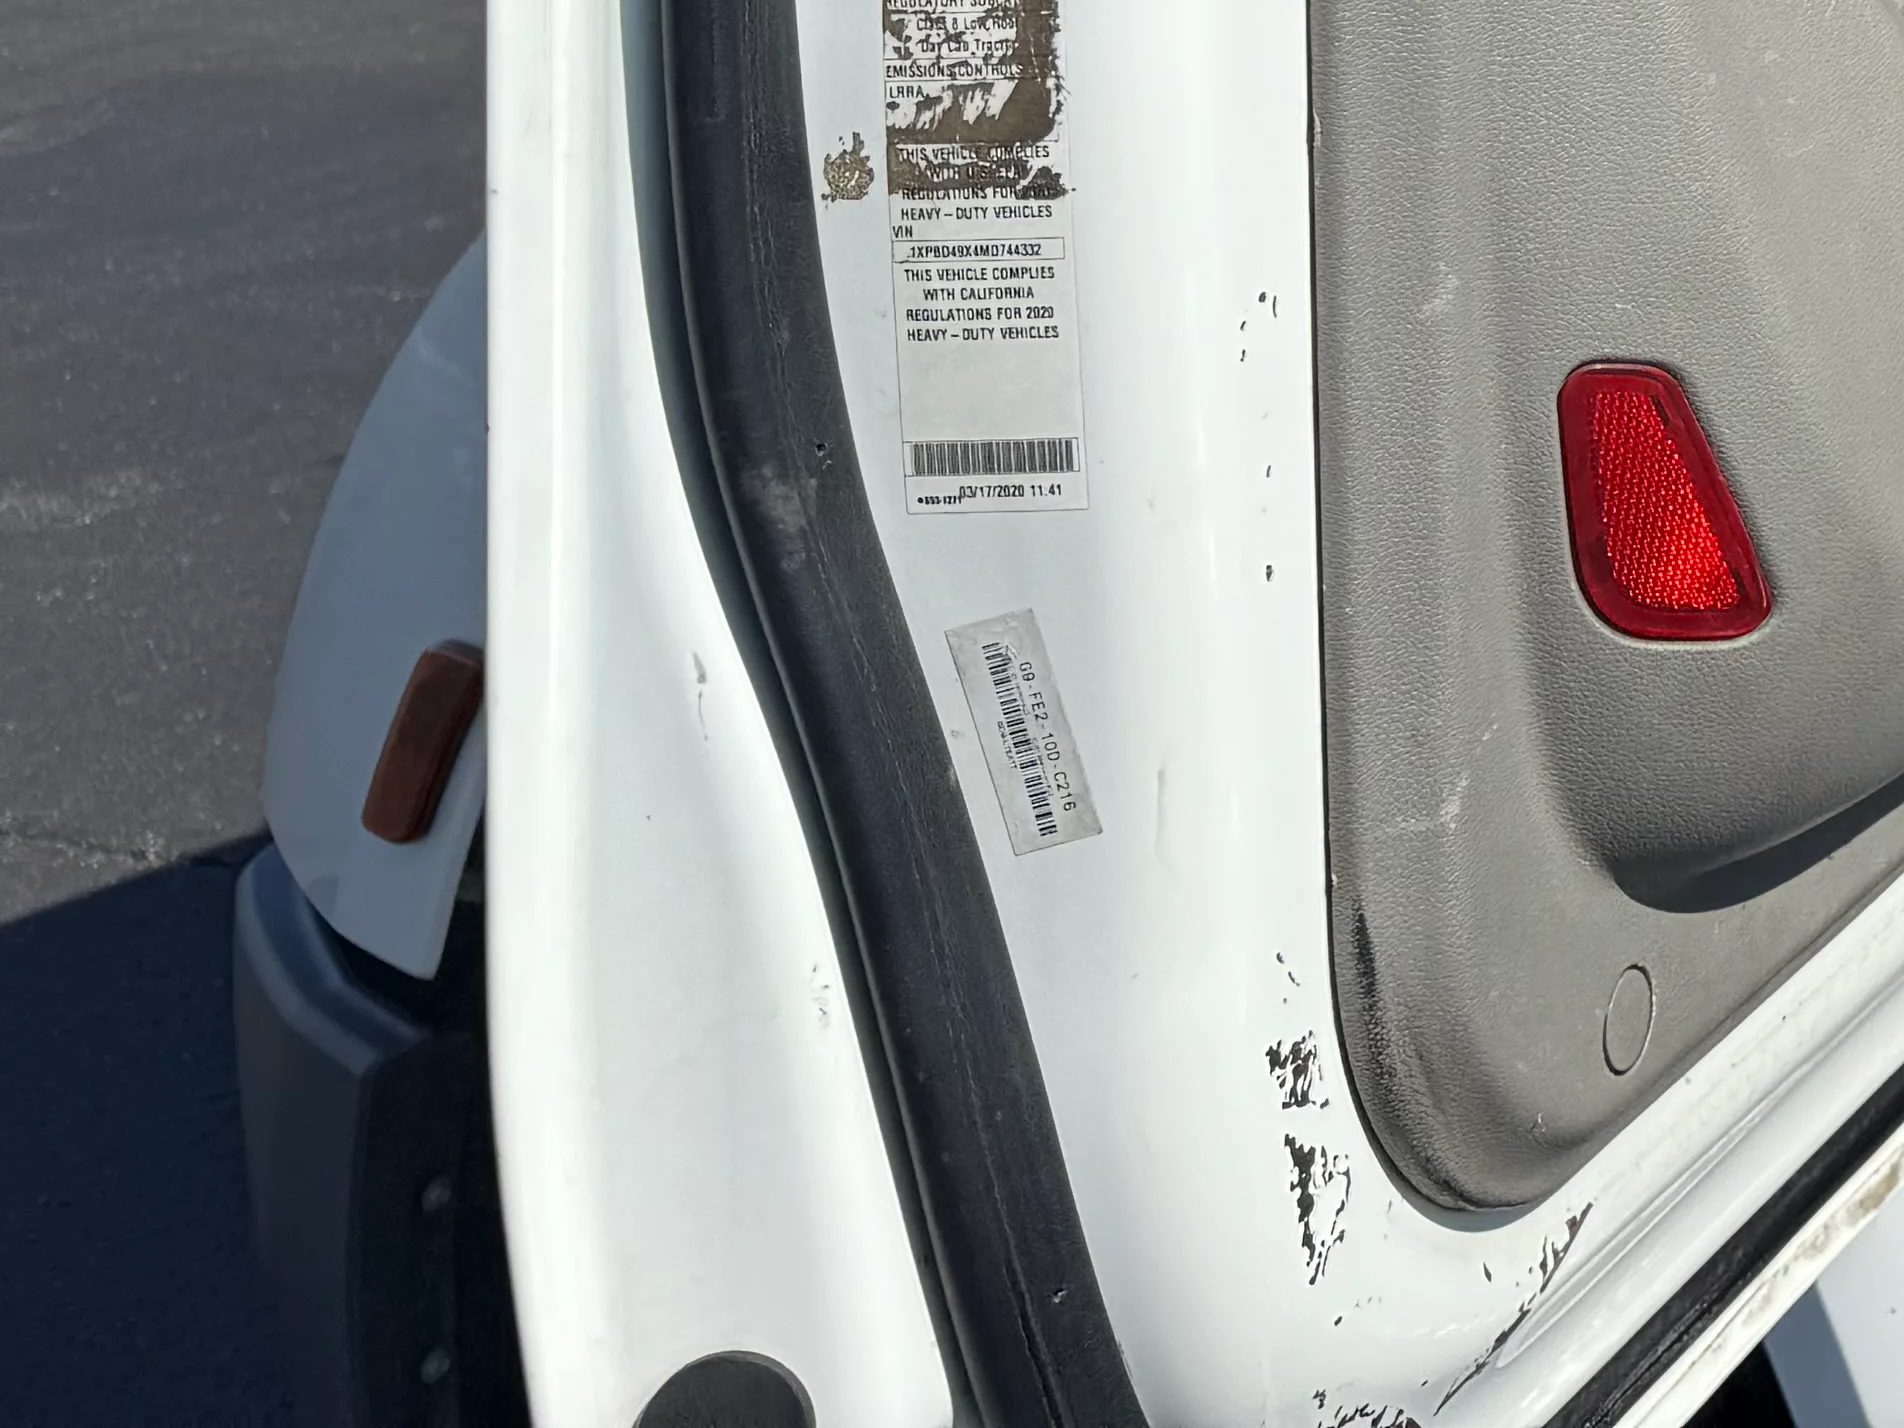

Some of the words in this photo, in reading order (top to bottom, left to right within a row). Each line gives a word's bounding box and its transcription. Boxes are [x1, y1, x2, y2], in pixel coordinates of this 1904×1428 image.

[886, 64, 953, 78] EMISSIONS
[900, 207, 941, 221] HEAVY
[956, 207, 988, 220] DUTY
[993, 205, 1053, 219] VEHICLES
[892, 225, 913, 239] VIN
[904, 268, 932, 282] THIS
[936, 267, 987, 282] VEHICLE
[992, 266, 1055, 280] COMPLIES
[923, 287, 955, 301] WITH
[960, 286, 1035, 301] CALIFORNIA
[906, 307, 992, 322] REGULATIONS
[997, 307, 1022, 321] FOR
[1025, 306, 1055, 320] 2020
[907, 328, 948, 342] HEAVY
[962, 327, 995, 341] DUTY
[1000, 325, 1060, 340] VEHICLES
[958, 484, 1025, 499] 03/17/2020
